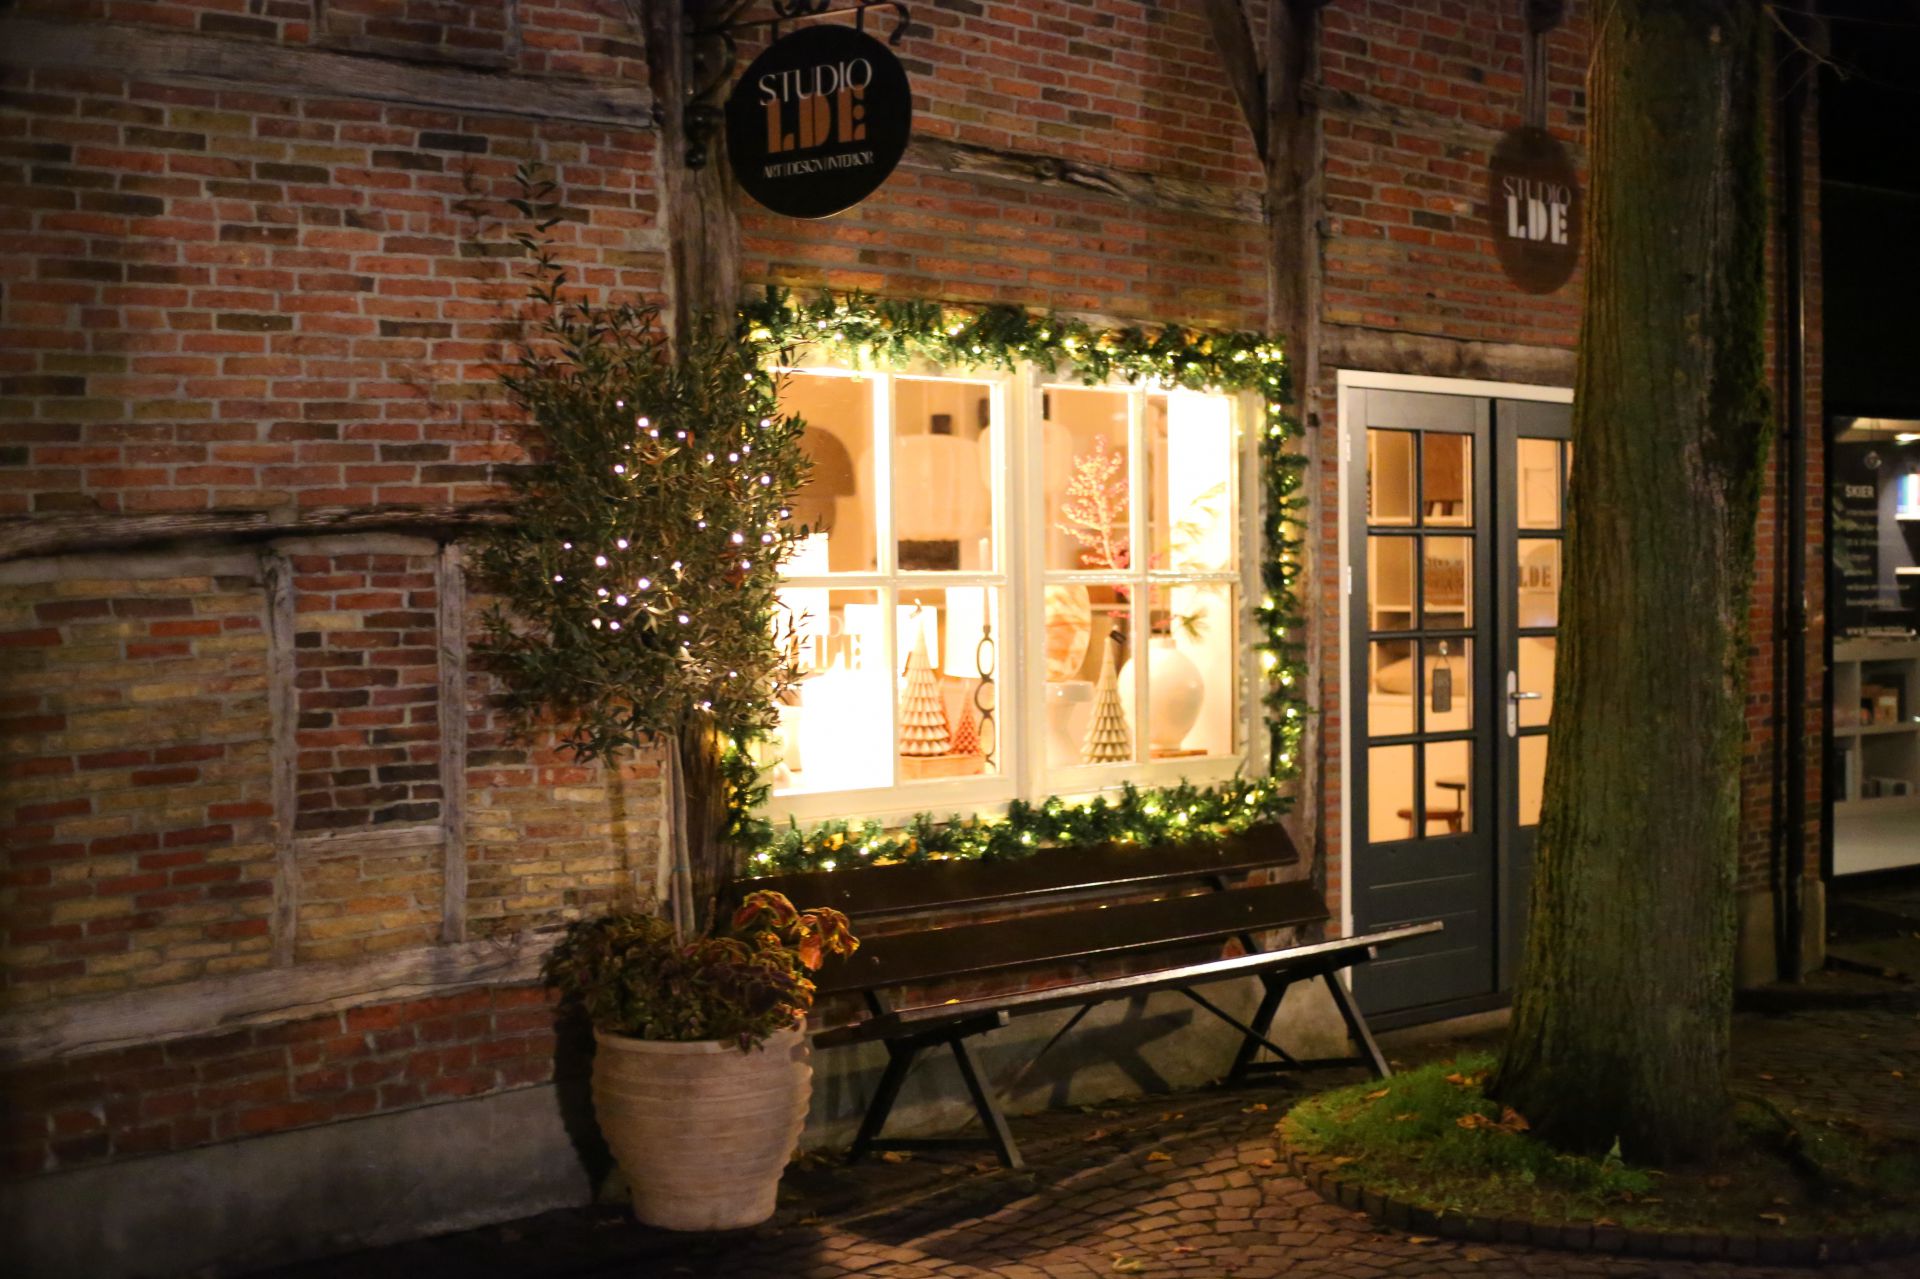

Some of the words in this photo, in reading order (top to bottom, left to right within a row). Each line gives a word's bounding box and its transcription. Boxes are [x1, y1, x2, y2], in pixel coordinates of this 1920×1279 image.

[758, 58, 873, 106] STUDIO
[766, 84, 867, 154] LDE
[1502, 176, 1572, 206] STUDIO
[1507, 195, 1569, 245] LDE
